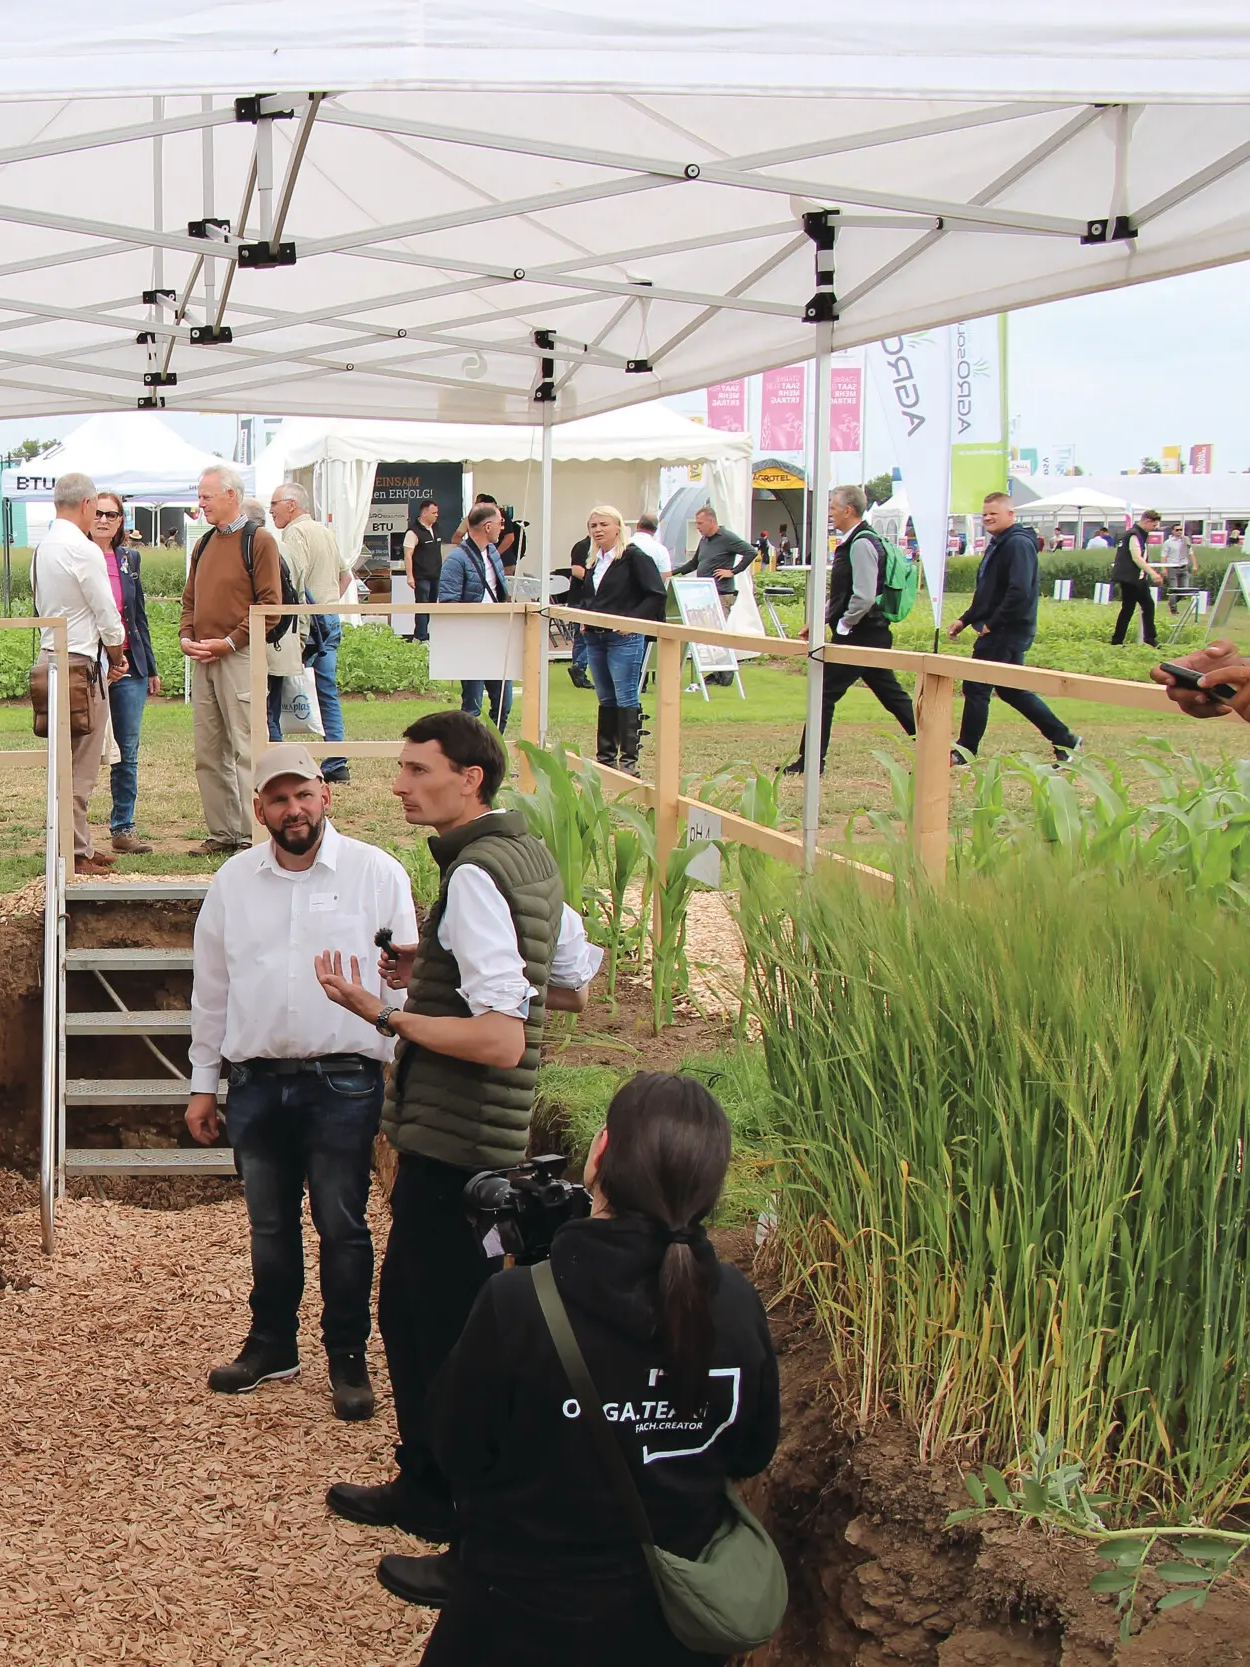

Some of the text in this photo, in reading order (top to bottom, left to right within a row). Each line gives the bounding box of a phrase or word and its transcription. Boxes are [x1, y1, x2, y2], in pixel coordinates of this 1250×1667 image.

[16, 476, 56, 490] BTU
[389, 489, 433, 499] ERFOLG!
[372, 523, 394, 531] BTU
